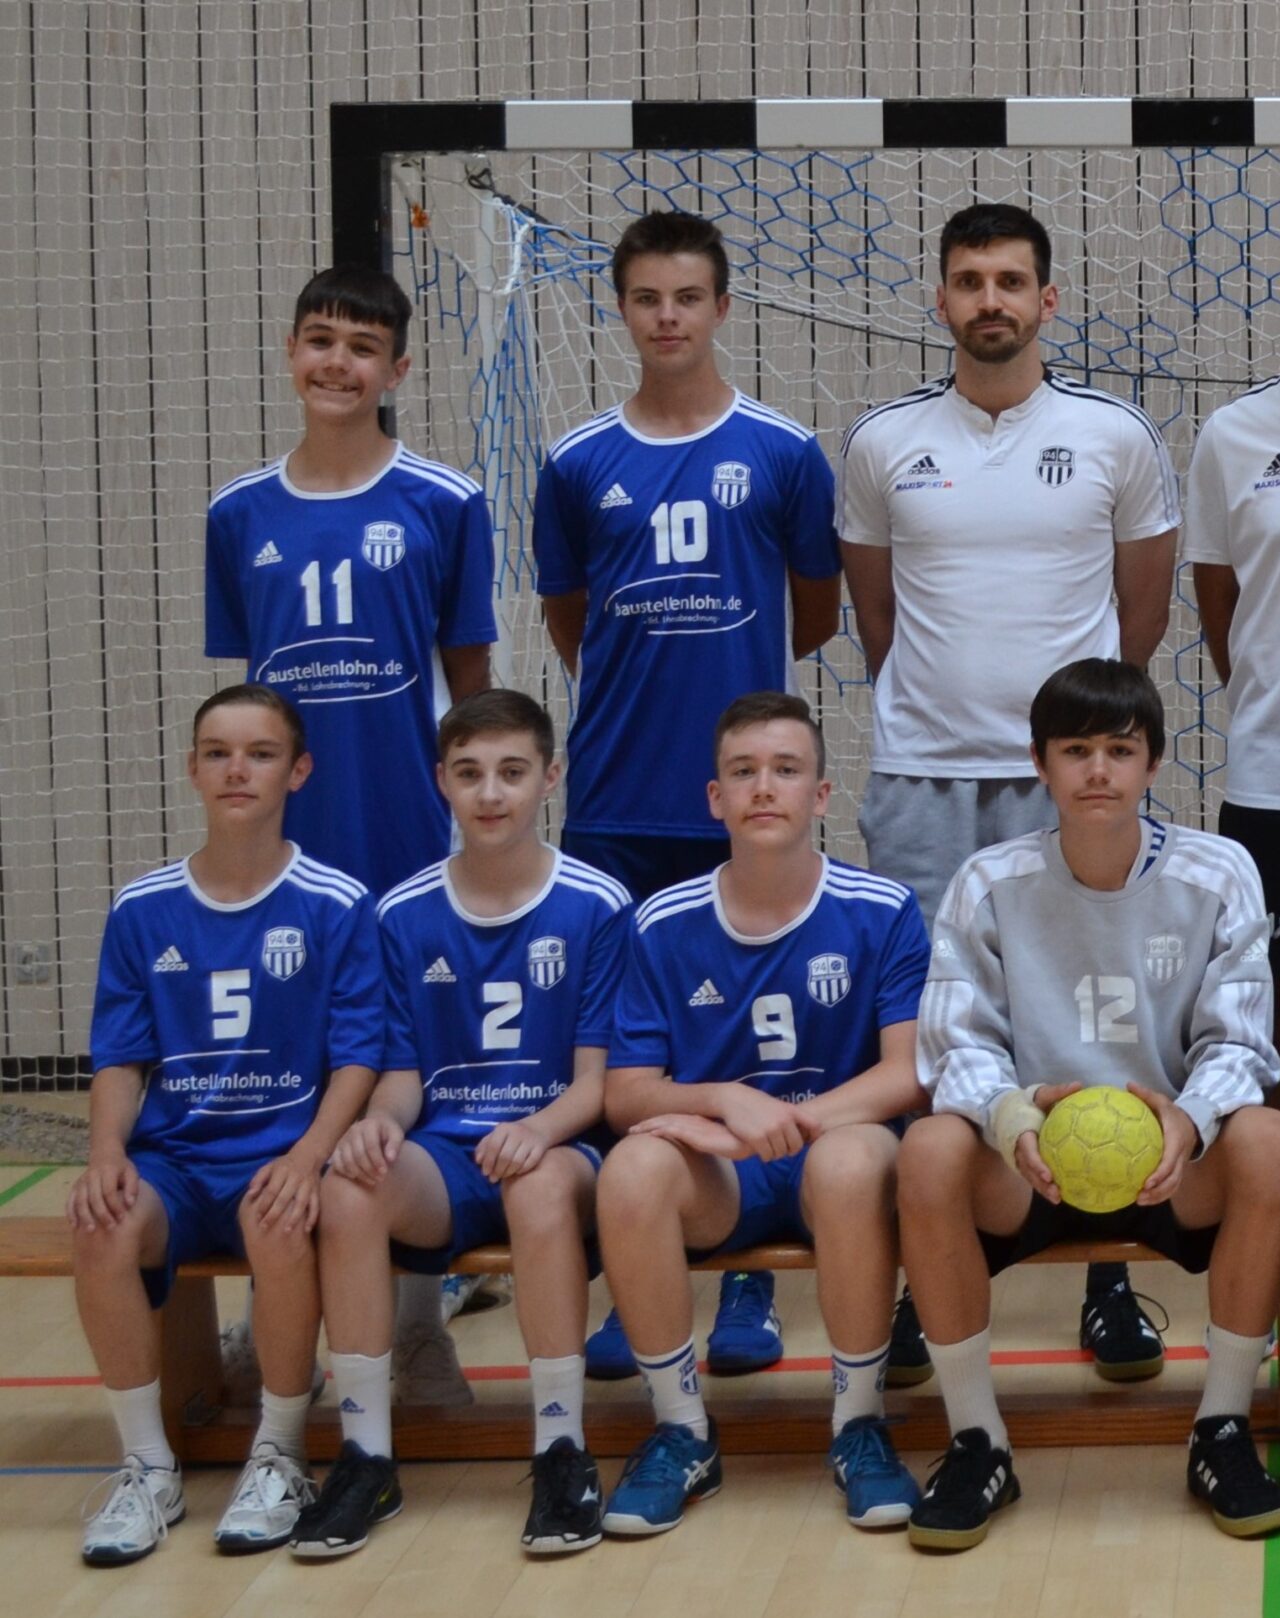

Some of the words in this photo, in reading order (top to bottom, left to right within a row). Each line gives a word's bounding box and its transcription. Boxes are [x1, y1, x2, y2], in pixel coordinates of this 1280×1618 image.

[1043, 450, 1056, 460] 94
[908, 467, 940, 475] adidas
[600, 497, 633, 509] adidas
[369, 527, 383, 537] 94
[651, 500, 708, 564] 10
[301, 558, 353, 627] 11
[266, 659, 403, 684] austellenlohn.de
[268, 934, 283, 944] 94
[153, 961, 189, 972] adidas
[812, 961, 827, 972] 94
[423, 974, 457, 983] adidas
[211, 968, 251, 1039] 5
[688, 995, 724, 1007] adidas
[1074, 975, 1138, 1043] 12
[482, 981, 523, 1050] 2
[751, 993, 797, 1061] 9
